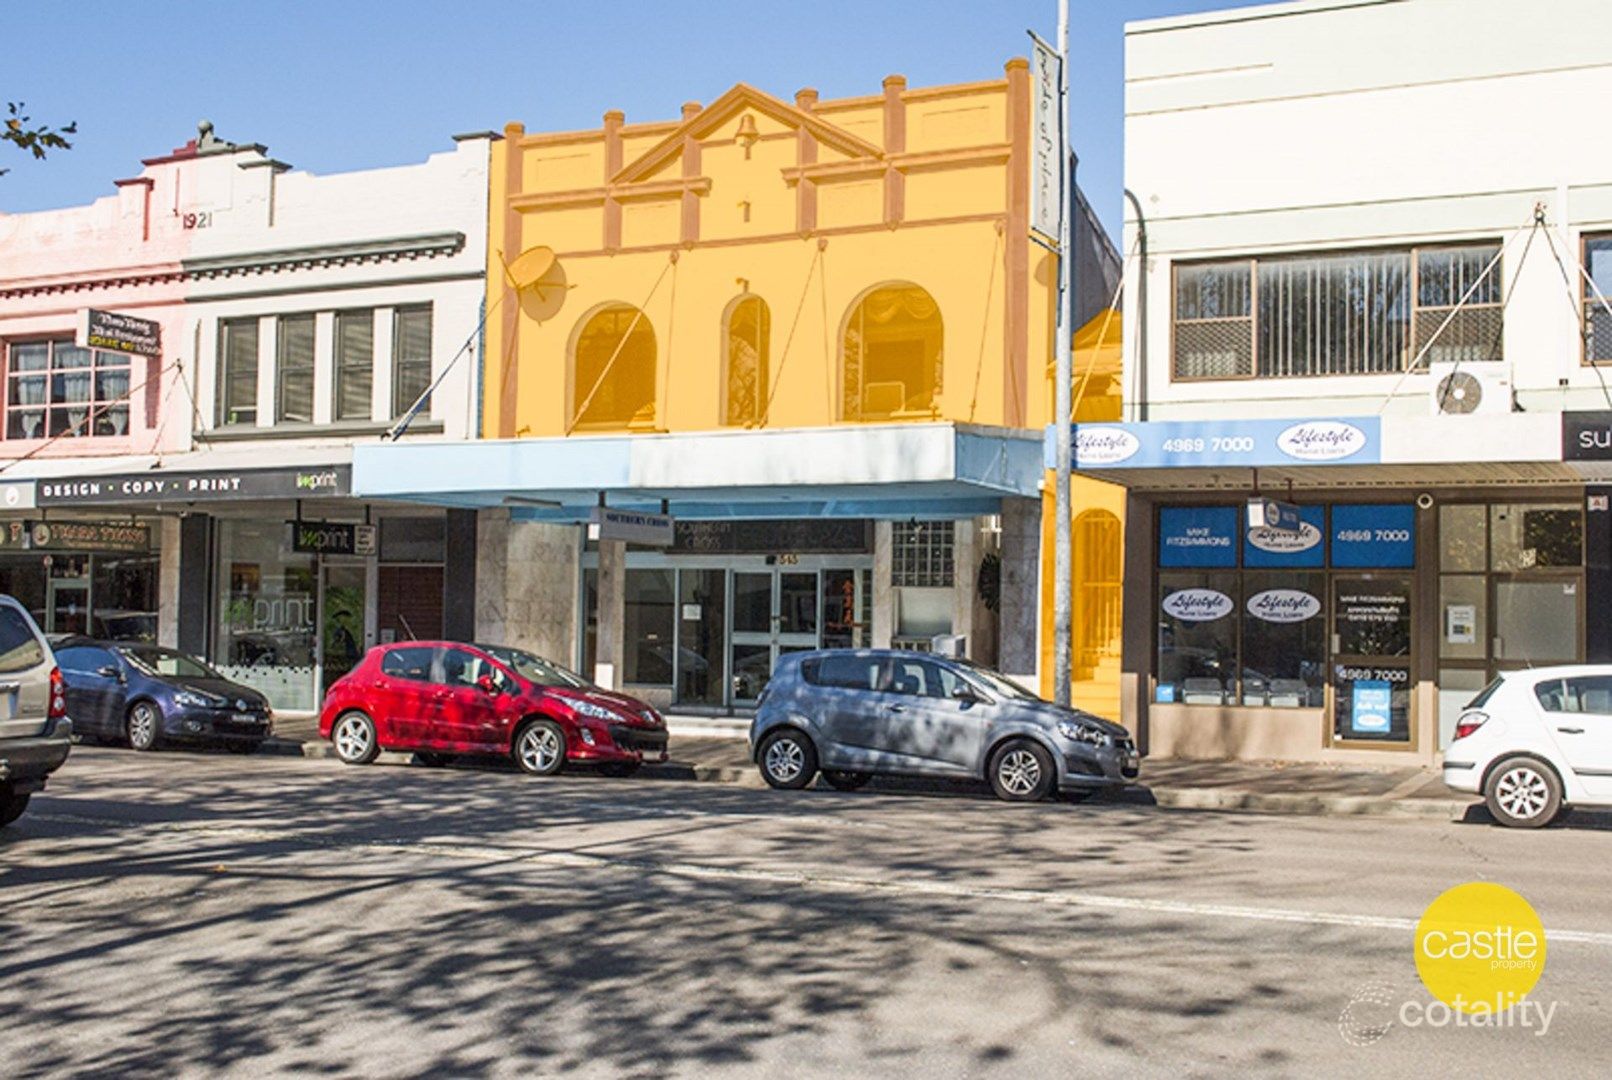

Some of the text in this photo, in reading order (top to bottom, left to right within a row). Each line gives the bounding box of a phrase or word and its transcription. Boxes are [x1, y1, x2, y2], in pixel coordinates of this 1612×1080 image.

[183, 211, 212, 230] 1921
[1162, 436, 1255, 453] 4969 7000
[1288, 427, 1354, 448] Lifestyle
[43, 477, 241, 497] DESIGN COPY PRINT
[1337, 529, 1410, 542] 4969 7000
[1171, 594, 1225, 610] Lifestyle
[1256, 594, 1312, 611] Lifestyle
[1373, 669, 1408, 682] 7000
